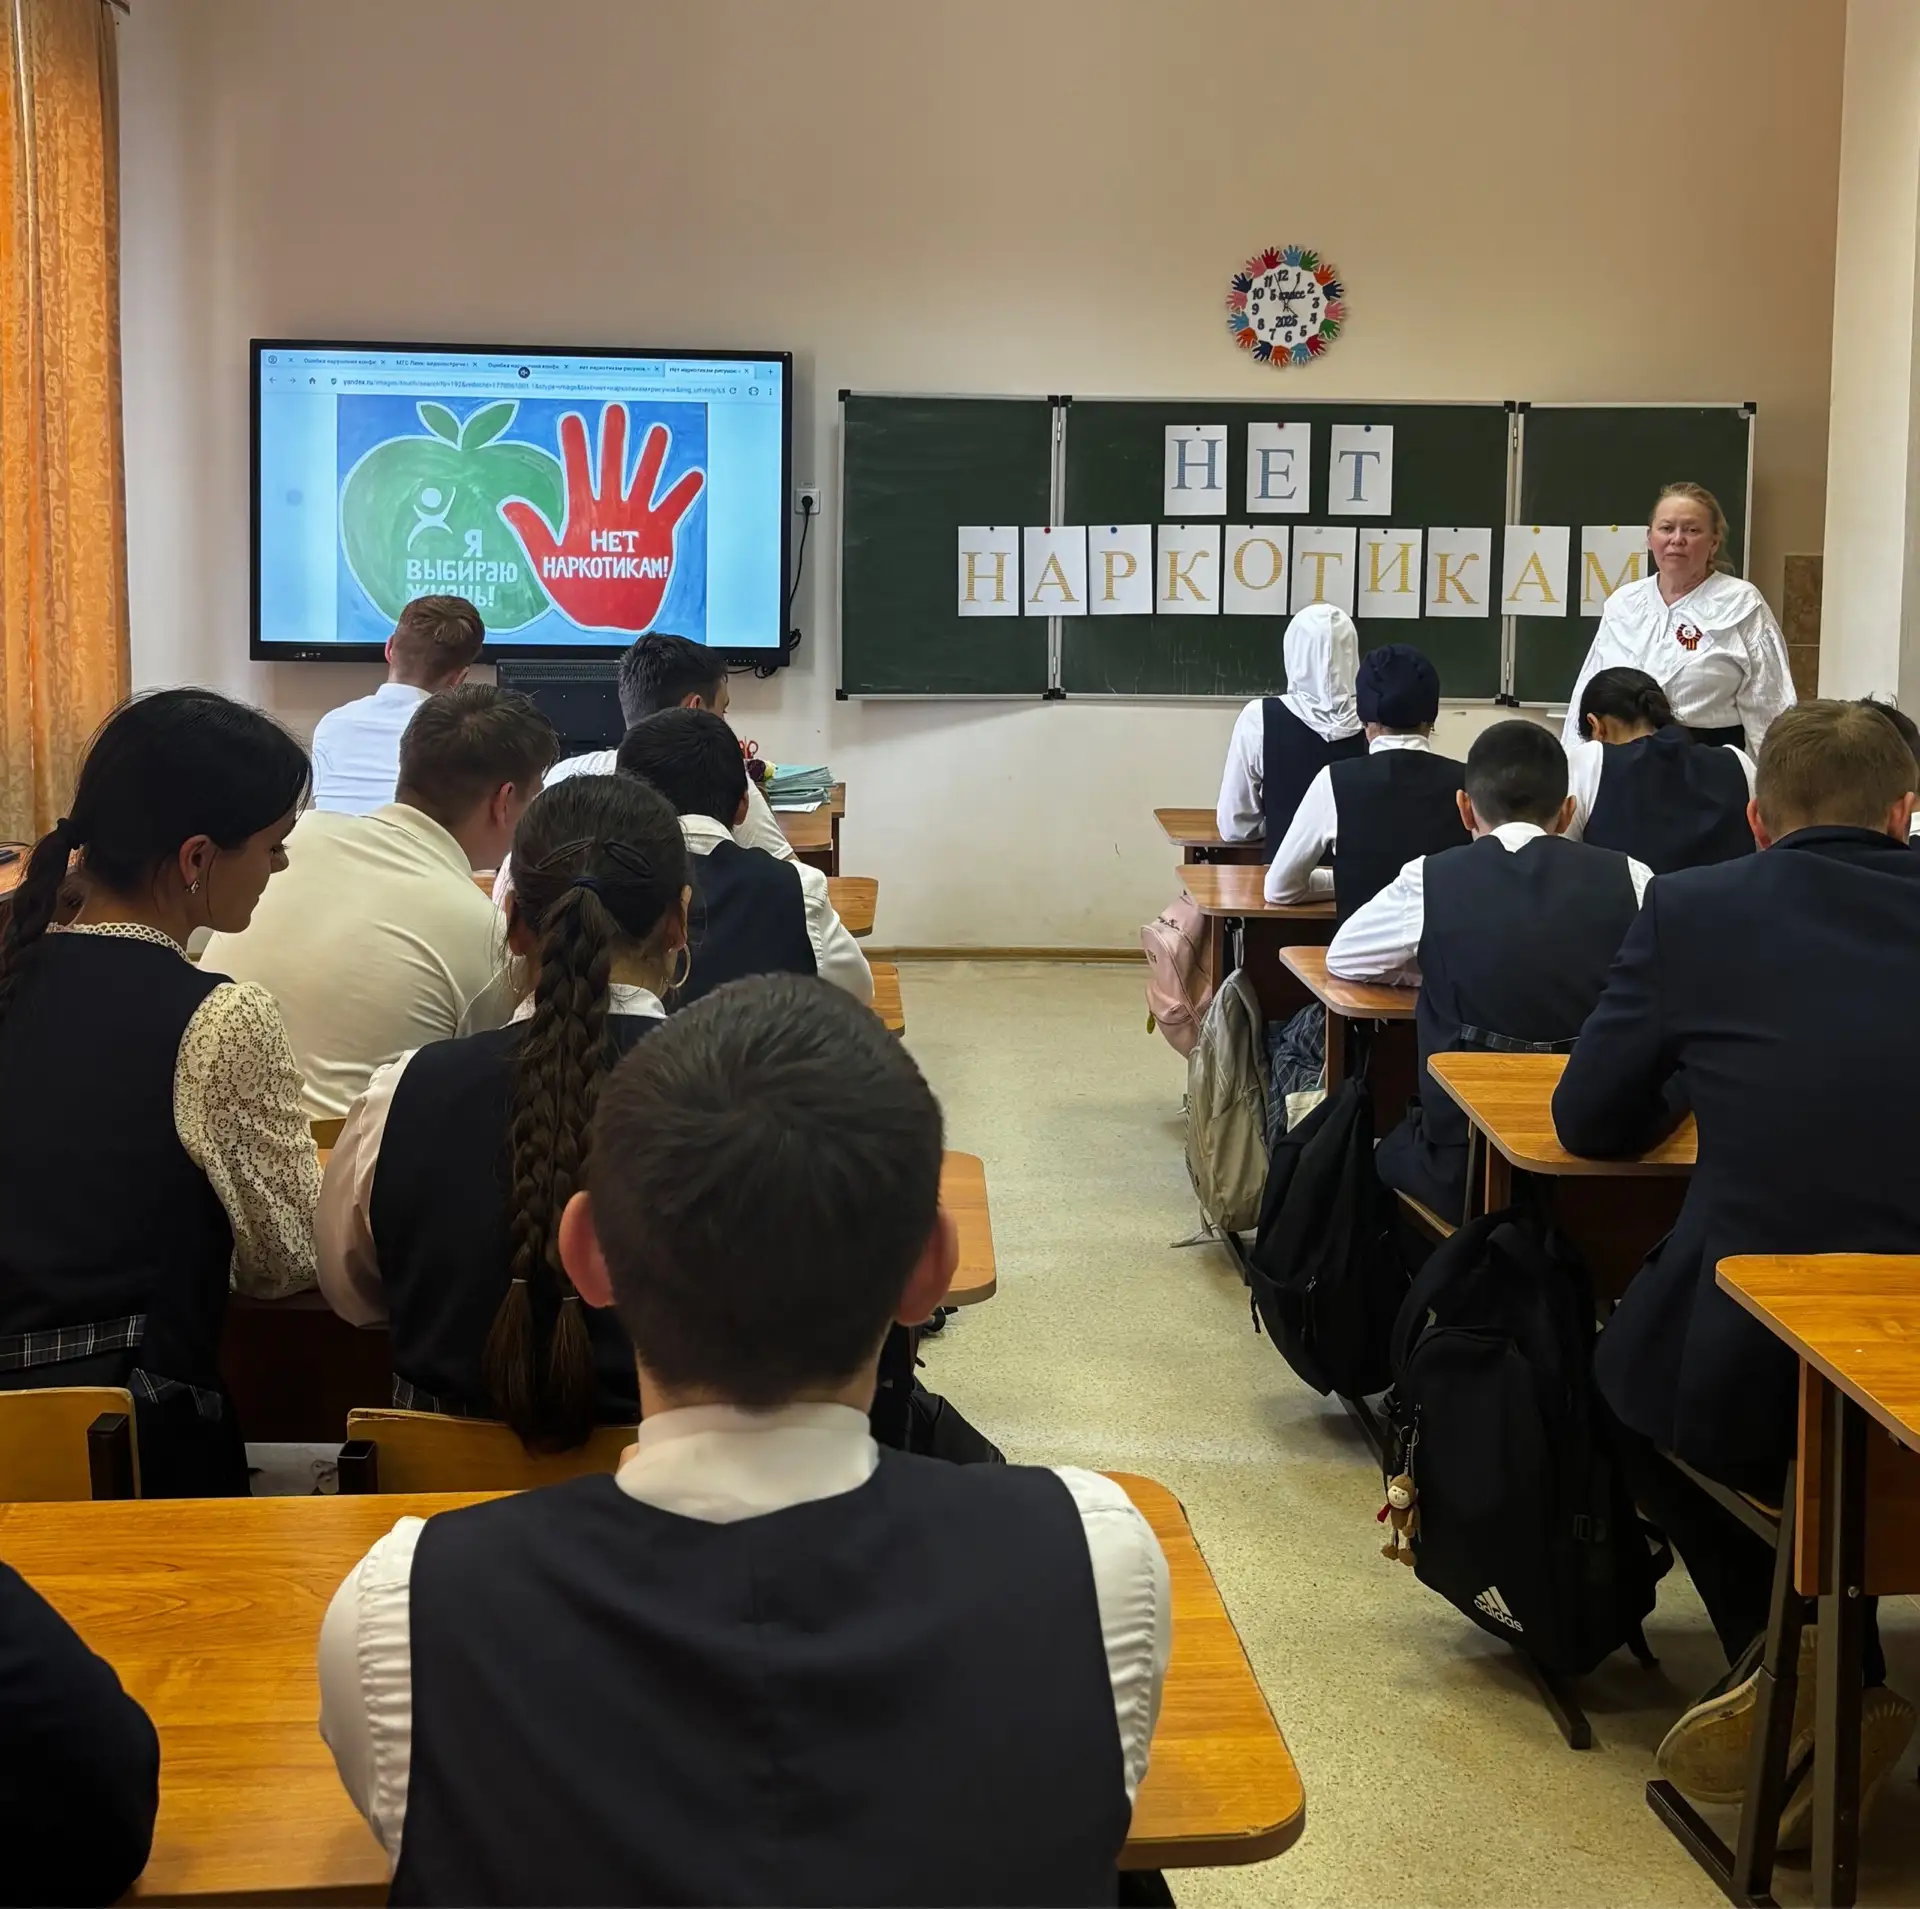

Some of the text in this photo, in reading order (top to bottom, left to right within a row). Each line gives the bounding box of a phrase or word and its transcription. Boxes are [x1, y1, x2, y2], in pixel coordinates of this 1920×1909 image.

[1264, 275, 1273, 287] 11
[1278, 270, 1289, 281] 12
[1296, 272, 1301, 285] 1
[1252, 288, 1264, 300] 10
[1307, 282, 1315, 294] 2
[1252, 303, 1259, 315] 9
[1312, 297, 1319, 309] 3
[1257, 318, 1265, 330] 8
[1310, 313, 1317, 324] 4
[1269, 328, 1276, 340] 7
[1285, 331, 1292, 342] 6
[1300, 325, 1307, 337] 5
[1171, 438, 1380, 502] НЕТ
[463, 529, 483, 558] Я
[591, 529, 639, 553] НЕТ
[406, 559, 518, 583] ВЫБИРАЮ
[543, 555, 669, 579] НАРКОТИКАМ!
[961, 538, 1648, 605] НАРКОТИКАМ
[1474, 1599, 1524, 1632] adidas
